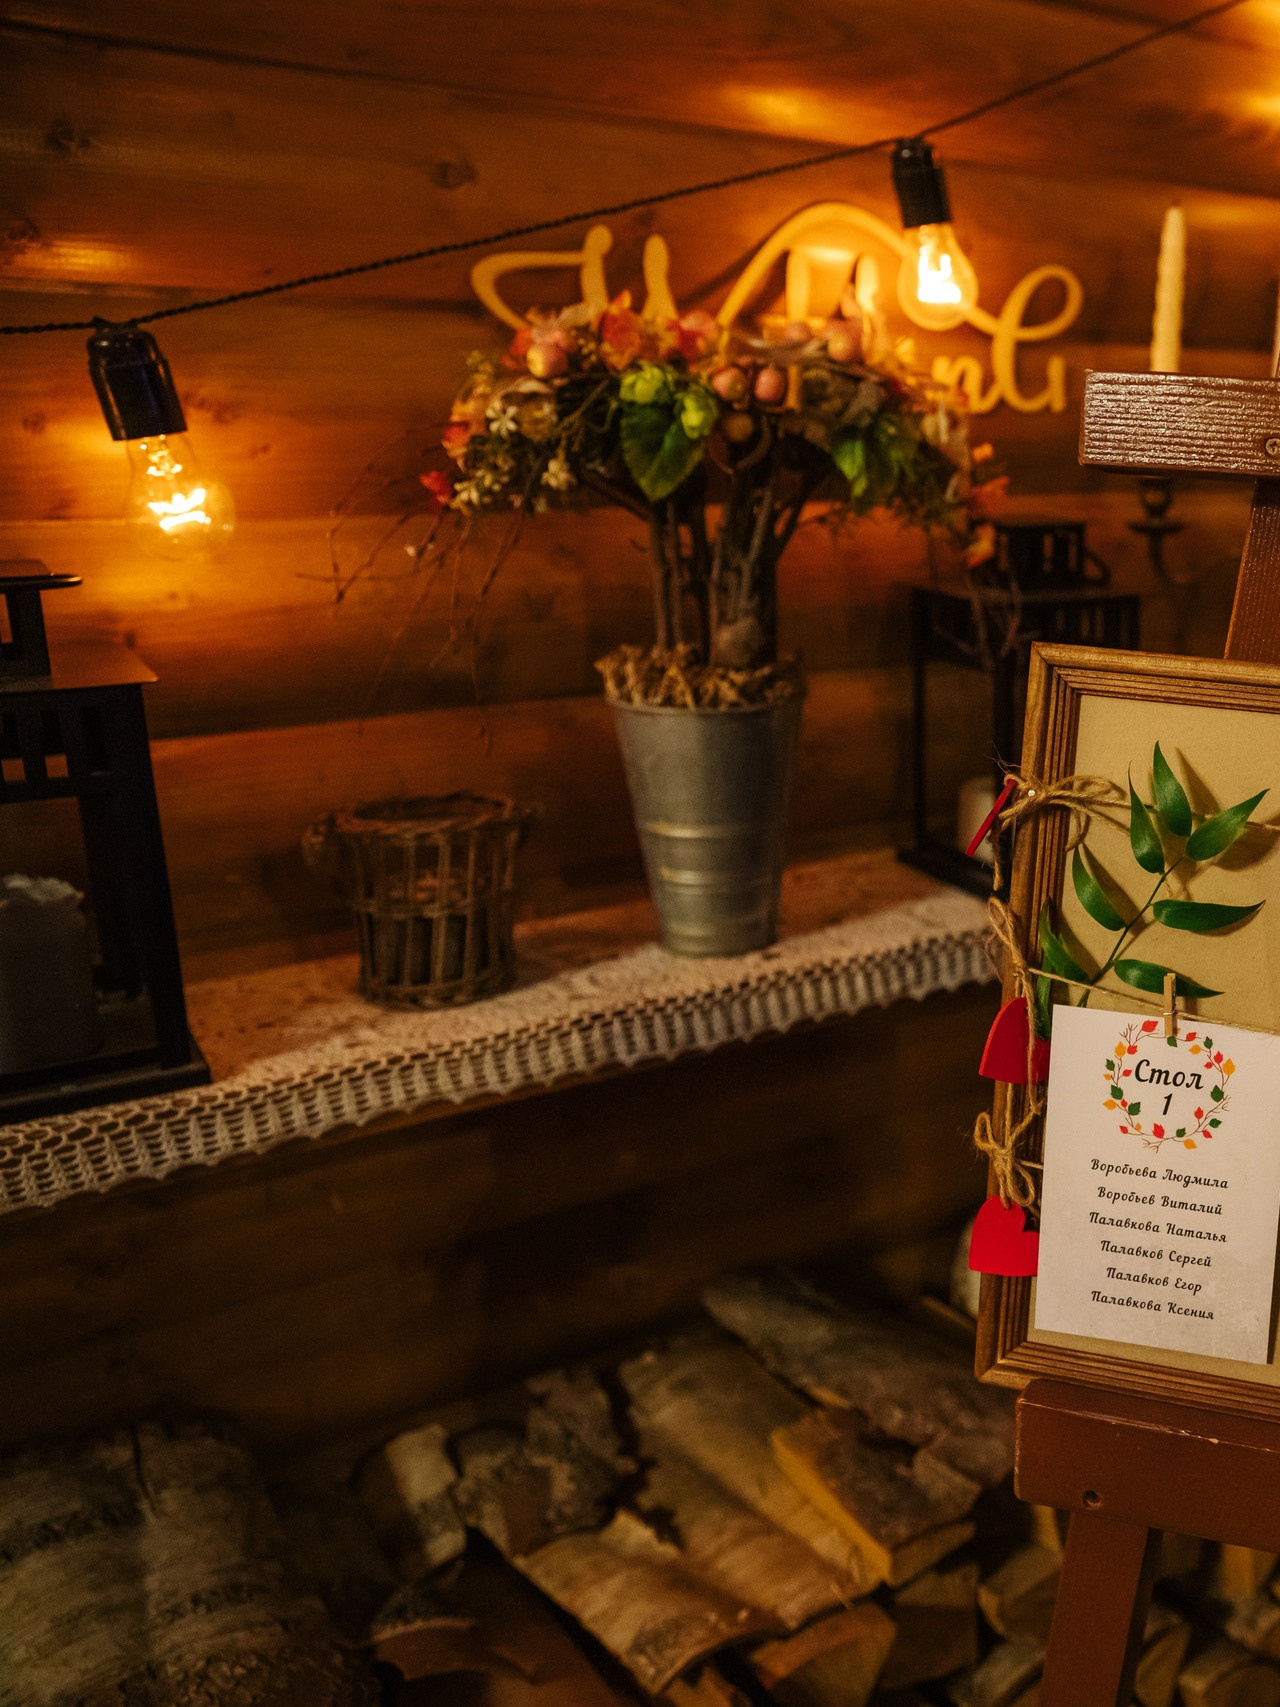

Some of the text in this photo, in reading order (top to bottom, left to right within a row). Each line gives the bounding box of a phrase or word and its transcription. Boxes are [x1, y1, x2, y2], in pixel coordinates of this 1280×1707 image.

[1135, 1059, 1204, 1090] Стол
[1162, 1093, 1173, 1115] 1
[1091, 1159, 1228, 1189] Воробьева Людмила
[1098, 1187, 1222, 1215] Воробьев Виталий
[1089, 1212, 1226, 1242] Палавкова Наталья
[1101, 1240, 1211, 1268] Палавков Сергей
[1106, 1267, 1202, 1296] Палавков Егор
[1091, 1291, 1214, 1320] Палавкова Ксения
